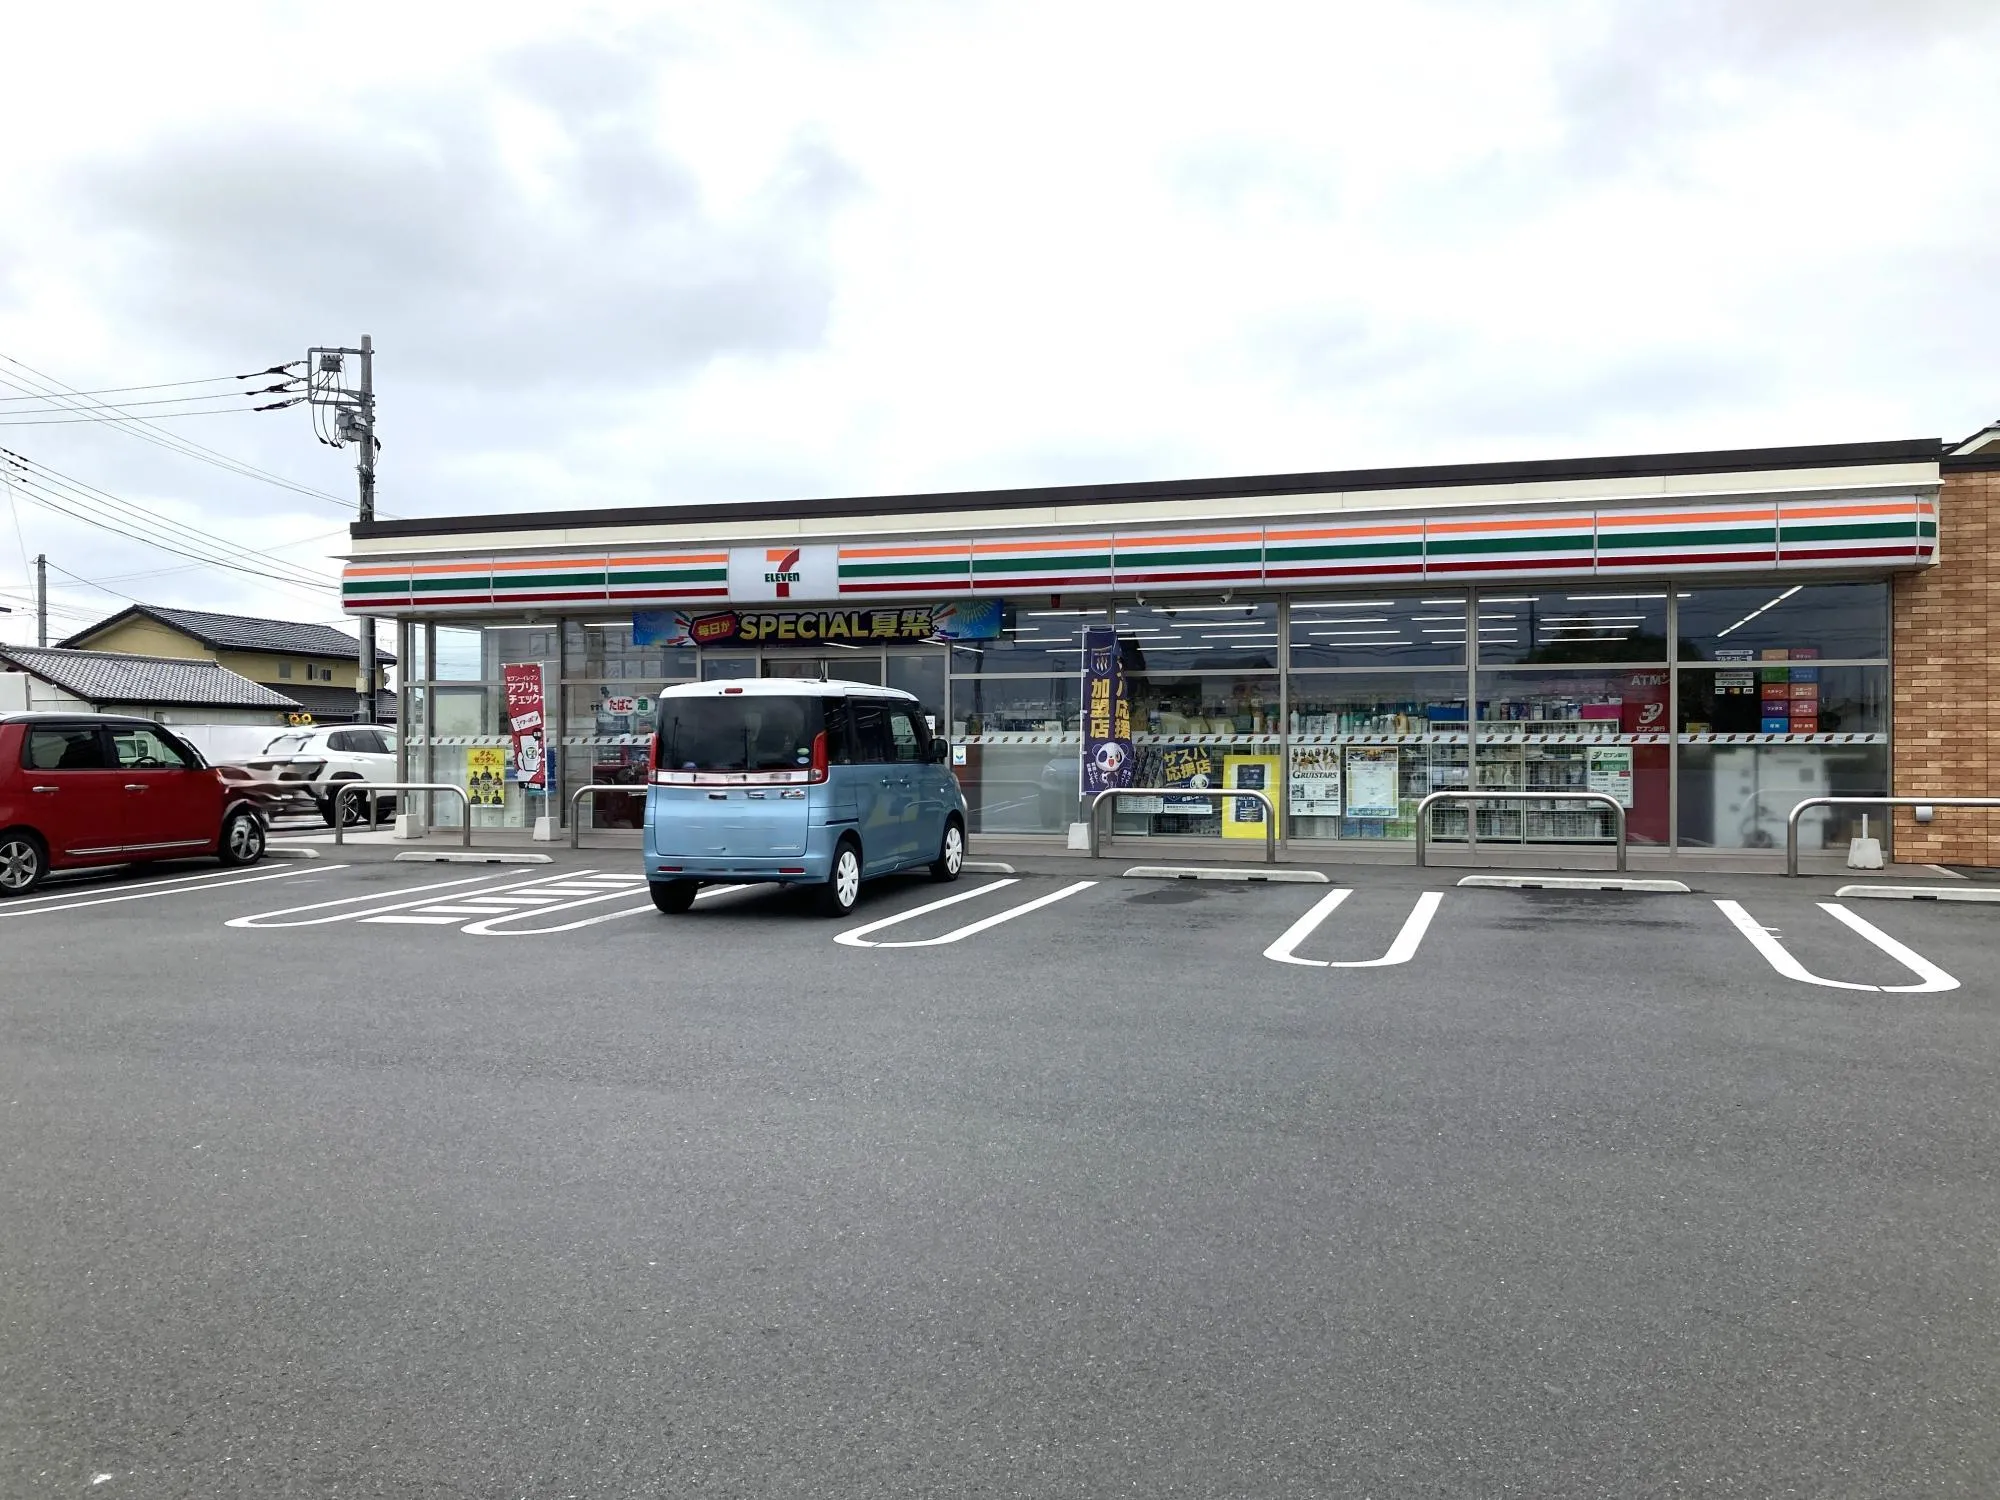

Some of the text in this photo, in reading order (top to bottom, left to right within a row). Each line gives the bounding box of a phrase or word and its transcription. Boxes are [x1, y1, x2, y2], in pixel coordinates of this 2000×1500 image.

[697, 620, 731, 637] 毎日が
[507, 682, 540, 694] アプリを
[508, 694, 540, 705] チェック
[608, 698, 633, 711] たばこ
[637, 698, 649, 711] 酒
[1090, 678, 1111, 739] 加盟店
[1165, 759, 1212, 782] 応援店
